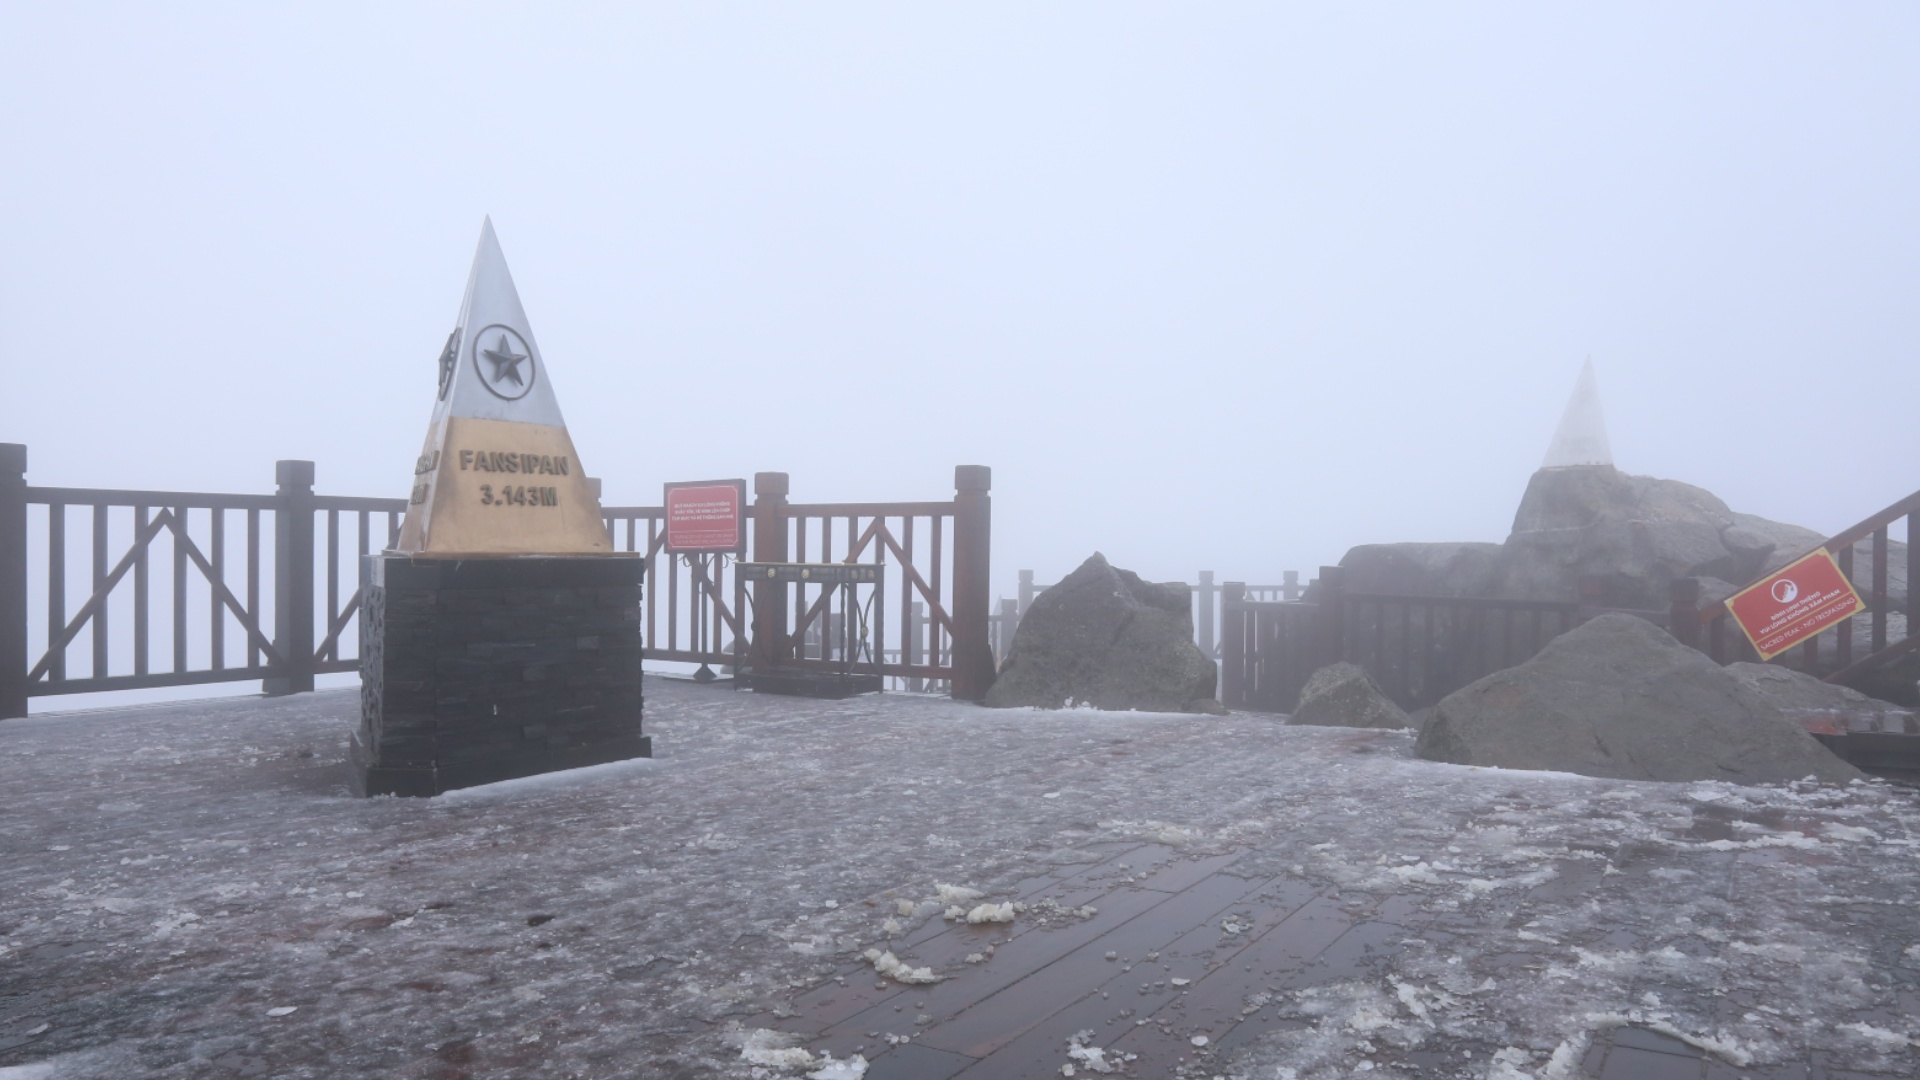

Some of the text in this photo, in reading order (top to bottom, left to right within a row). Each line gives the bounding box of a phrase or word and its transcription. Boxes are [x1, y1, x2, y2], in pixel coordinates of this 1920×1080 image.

[459, 450, 570, 476] FANSIPAN
[480, 484, 558, 507] 3.143M
[1761, 636, 1784, 650] SACRED
[1784, 627, 1800, 638] PEAK
[1803, 618, 1816, 628] NO
[1815, 597, 1855, 621] TRESPASSING
